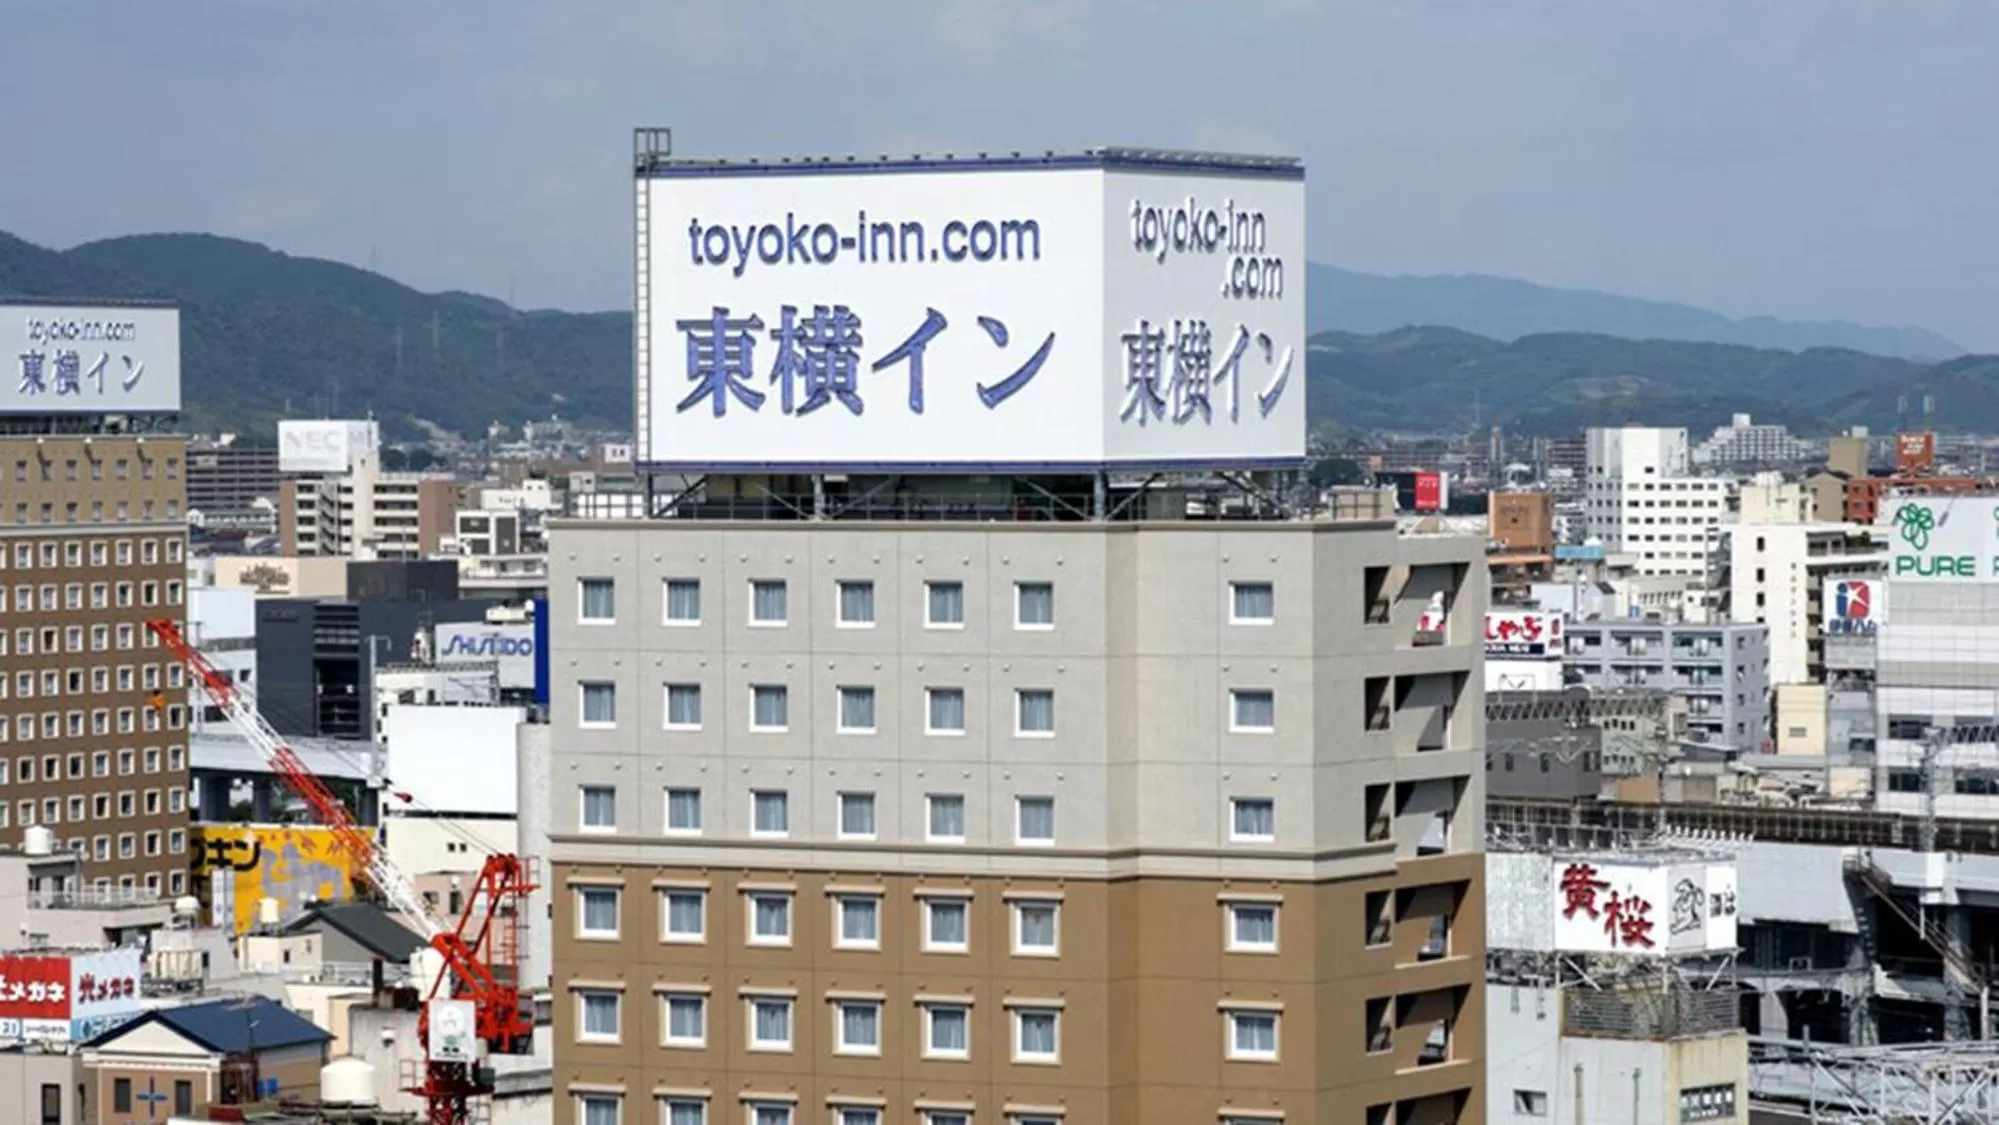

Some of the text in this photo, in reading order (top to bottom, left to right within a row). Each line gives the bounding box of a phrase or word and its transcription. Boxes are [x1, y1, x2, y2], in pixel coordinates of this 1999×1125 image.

[687, 209, 1041, 278] toyoko-inn.com
[1131, 196, 1266, 262] toyoko-inn
[18, 349, 145, 396] 東横イン
[675, 304, 1057, 419] 東横イン
[1119, 317, 1294, 427] 東横イン
[284, 430, 341, 450] NEC
[1895, 555, 1976, 577] PURE
